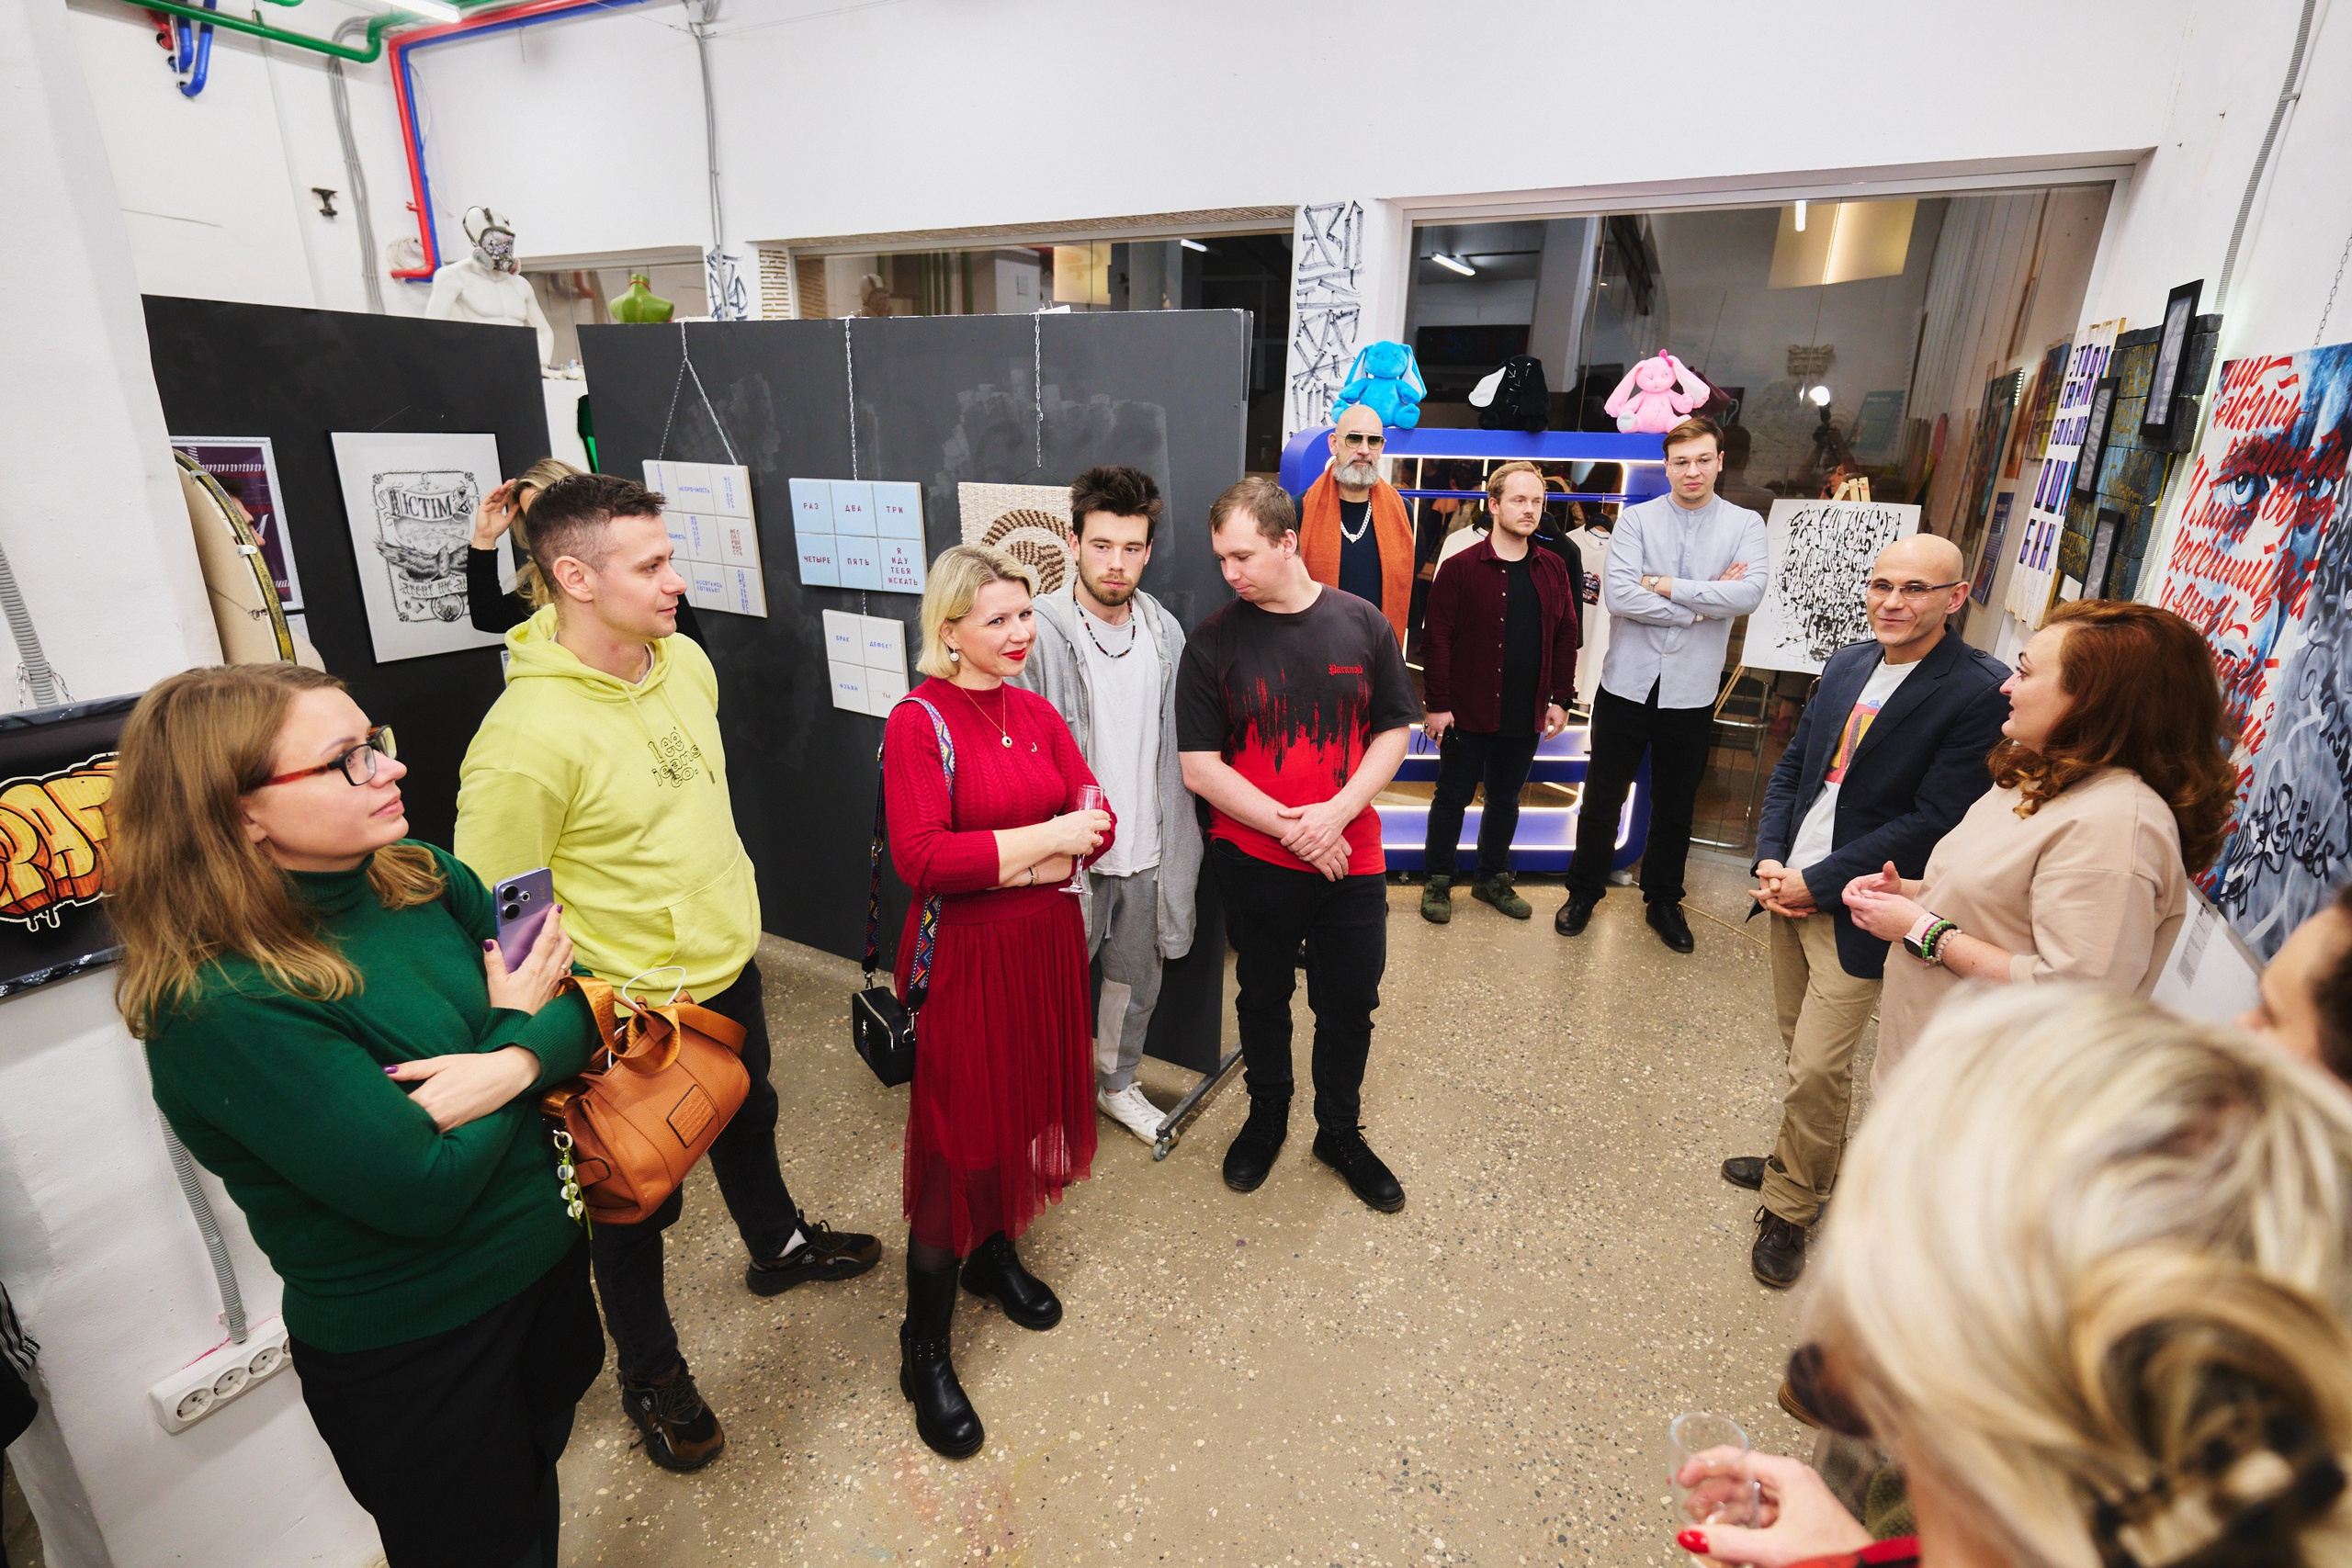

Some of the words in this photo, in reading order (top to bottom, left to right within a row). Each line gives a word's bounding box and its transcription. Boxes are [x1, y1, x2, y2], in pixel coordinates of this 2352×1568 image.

[844, 504, 863, 513] ДВА
[886, 505, 904, 513] ТРИ
[803, 556, 831, 564] ЧЕТЫРЕ
[847, 558, 870, 566] ПЯТЬ
[891, 557, 909, 565] ИДУ
[890, 566, 911, 575] ТЕБЯ
[888, 576, 919, 586] ИСКАТЬ
[835, 635, 850, 643] БРАК
[869, 640, 893, 649] ДЕФЕКТ
